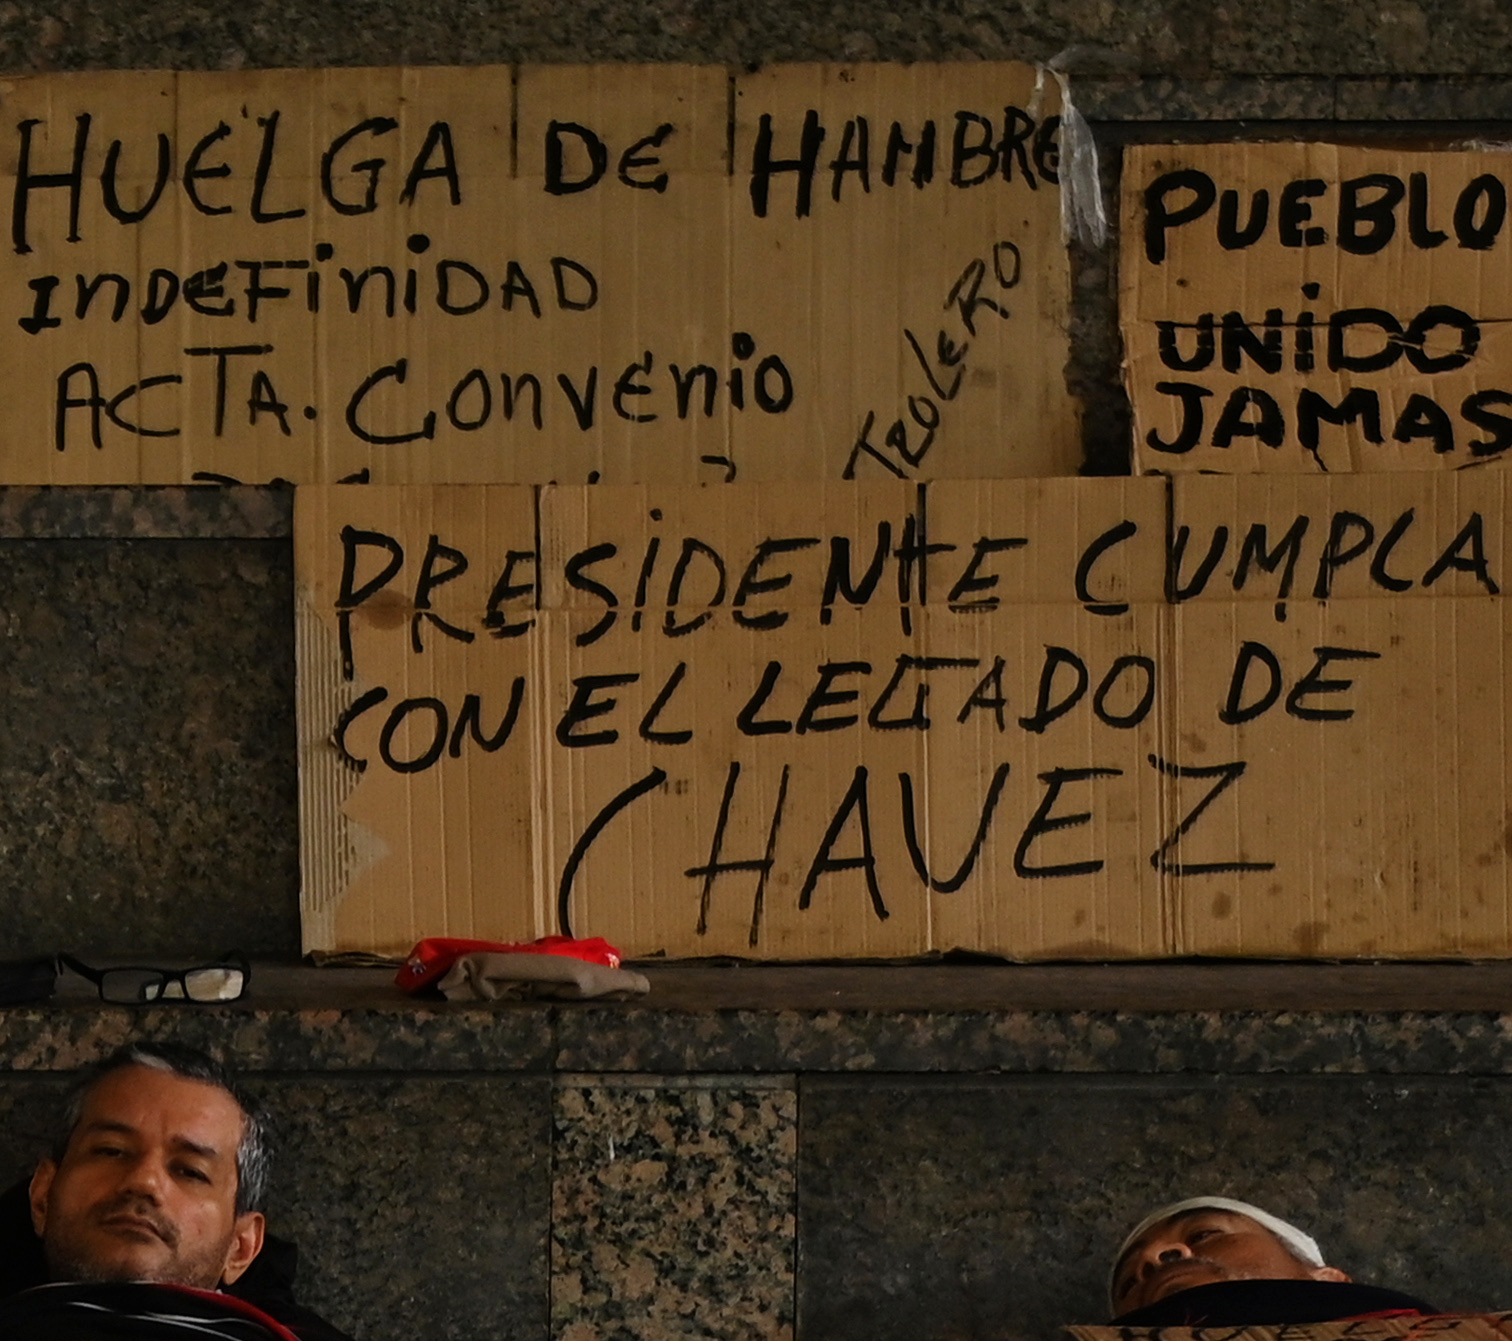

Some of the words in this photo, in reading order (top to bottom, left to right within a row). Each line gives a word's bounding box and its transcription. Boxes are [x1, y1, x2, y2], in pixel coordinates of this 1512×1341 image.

[13, 110, 462, 254] HUELGA
[749, 106, 1065, 220] HAMBRE
[1141, 168, 1509, 266] PUEBLO
[1075, 507, 1501, 623] CUMPLA
[330, 676, 526, 774] CON
[555, 663, 694, 749] EL
[735, 645, 1156, 736] LEGADO
[1218, 639, 1382, 725] DE
[558, 753, 1277, 948] CHAVEZ
